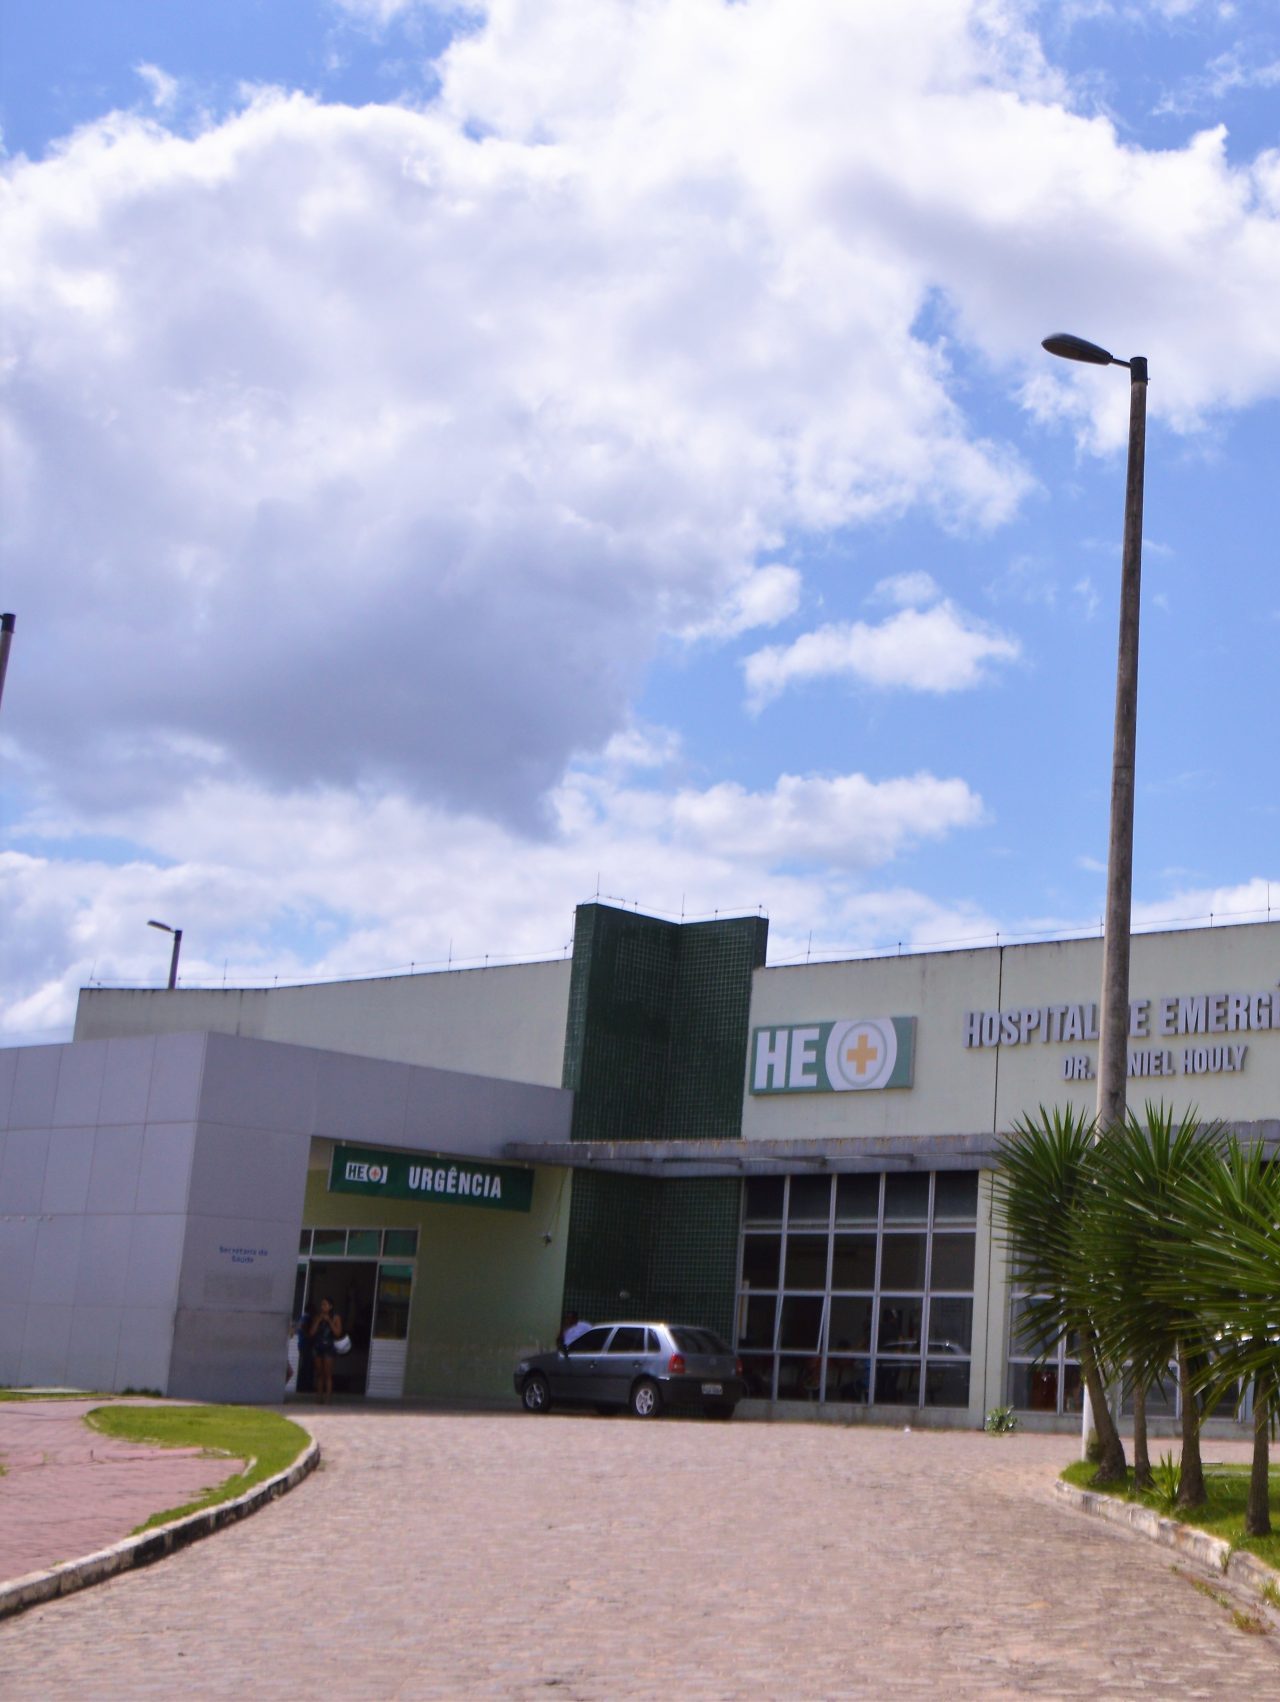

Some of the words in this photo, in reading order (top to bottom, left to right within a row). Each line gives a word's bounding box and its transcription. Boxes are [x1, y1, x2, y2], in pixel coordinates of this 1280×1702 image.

[963, 1001, 1100, 1050] HOSPITAL
[754, 1028, 820, 1090] HE
[1062, 1054, 1096, 1081] DR.
[1125, 1050, 1176, 1078] NIEL
[1183, 1046, 1248, 1075] HOULY
[408, 1165, 502, 1199] URGÊNCIA
